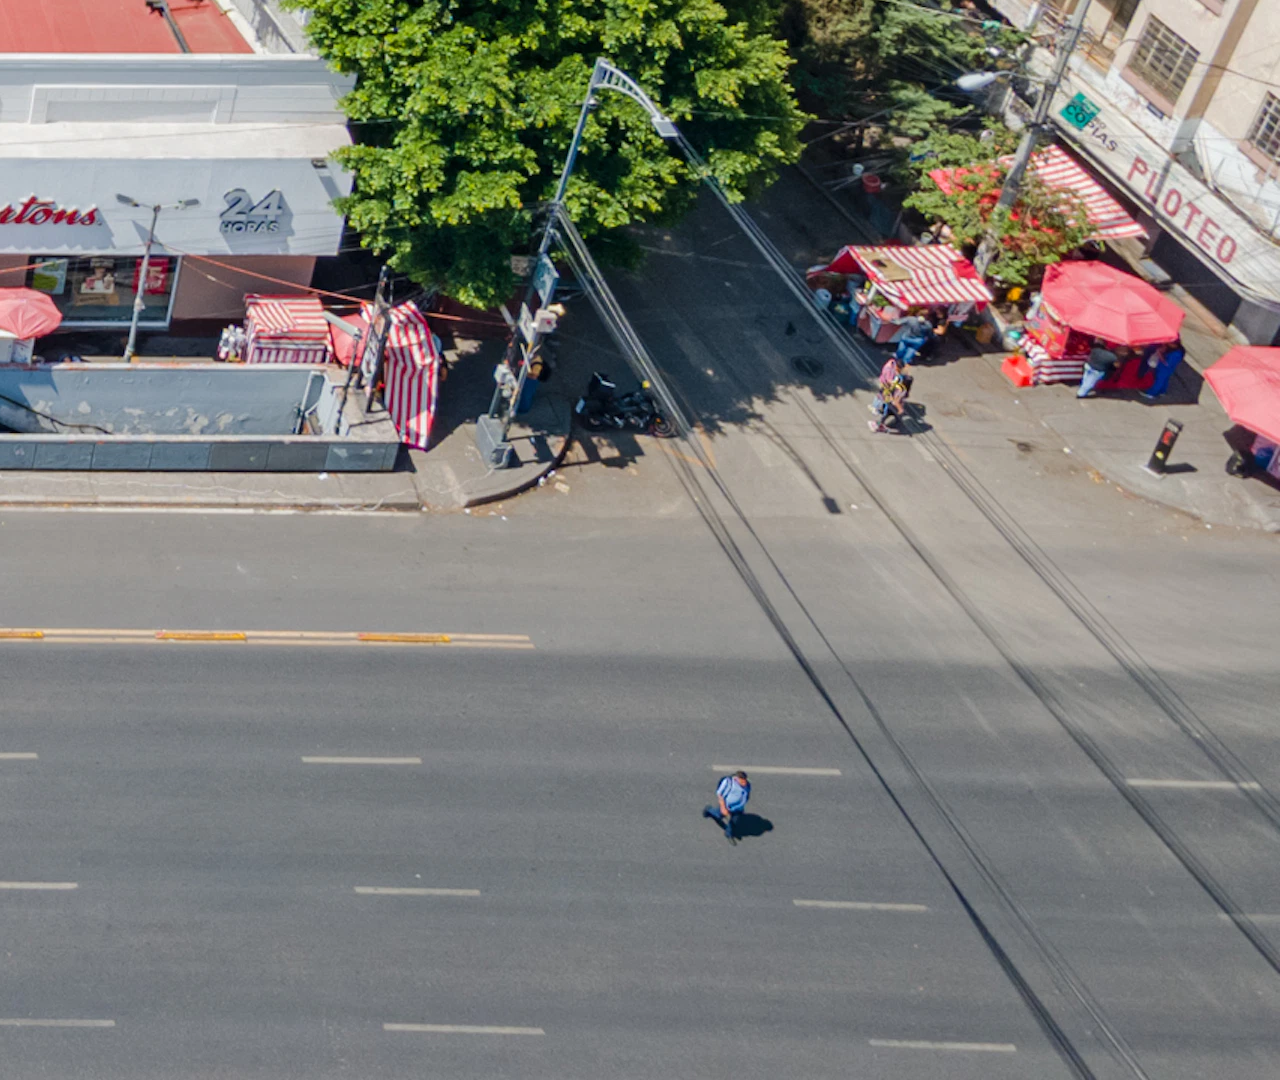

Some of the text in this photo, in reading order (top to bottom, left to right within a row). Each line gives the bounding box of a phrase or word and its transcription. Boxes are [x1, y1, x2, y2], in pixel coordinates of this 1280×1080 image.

[1065, 103, 1119, 152] COPIAS
[219, 188, 283, 220] 24
[1127, 155, 1237, 264] PLOTEO
[220, 220, 279, 234] HORAS
